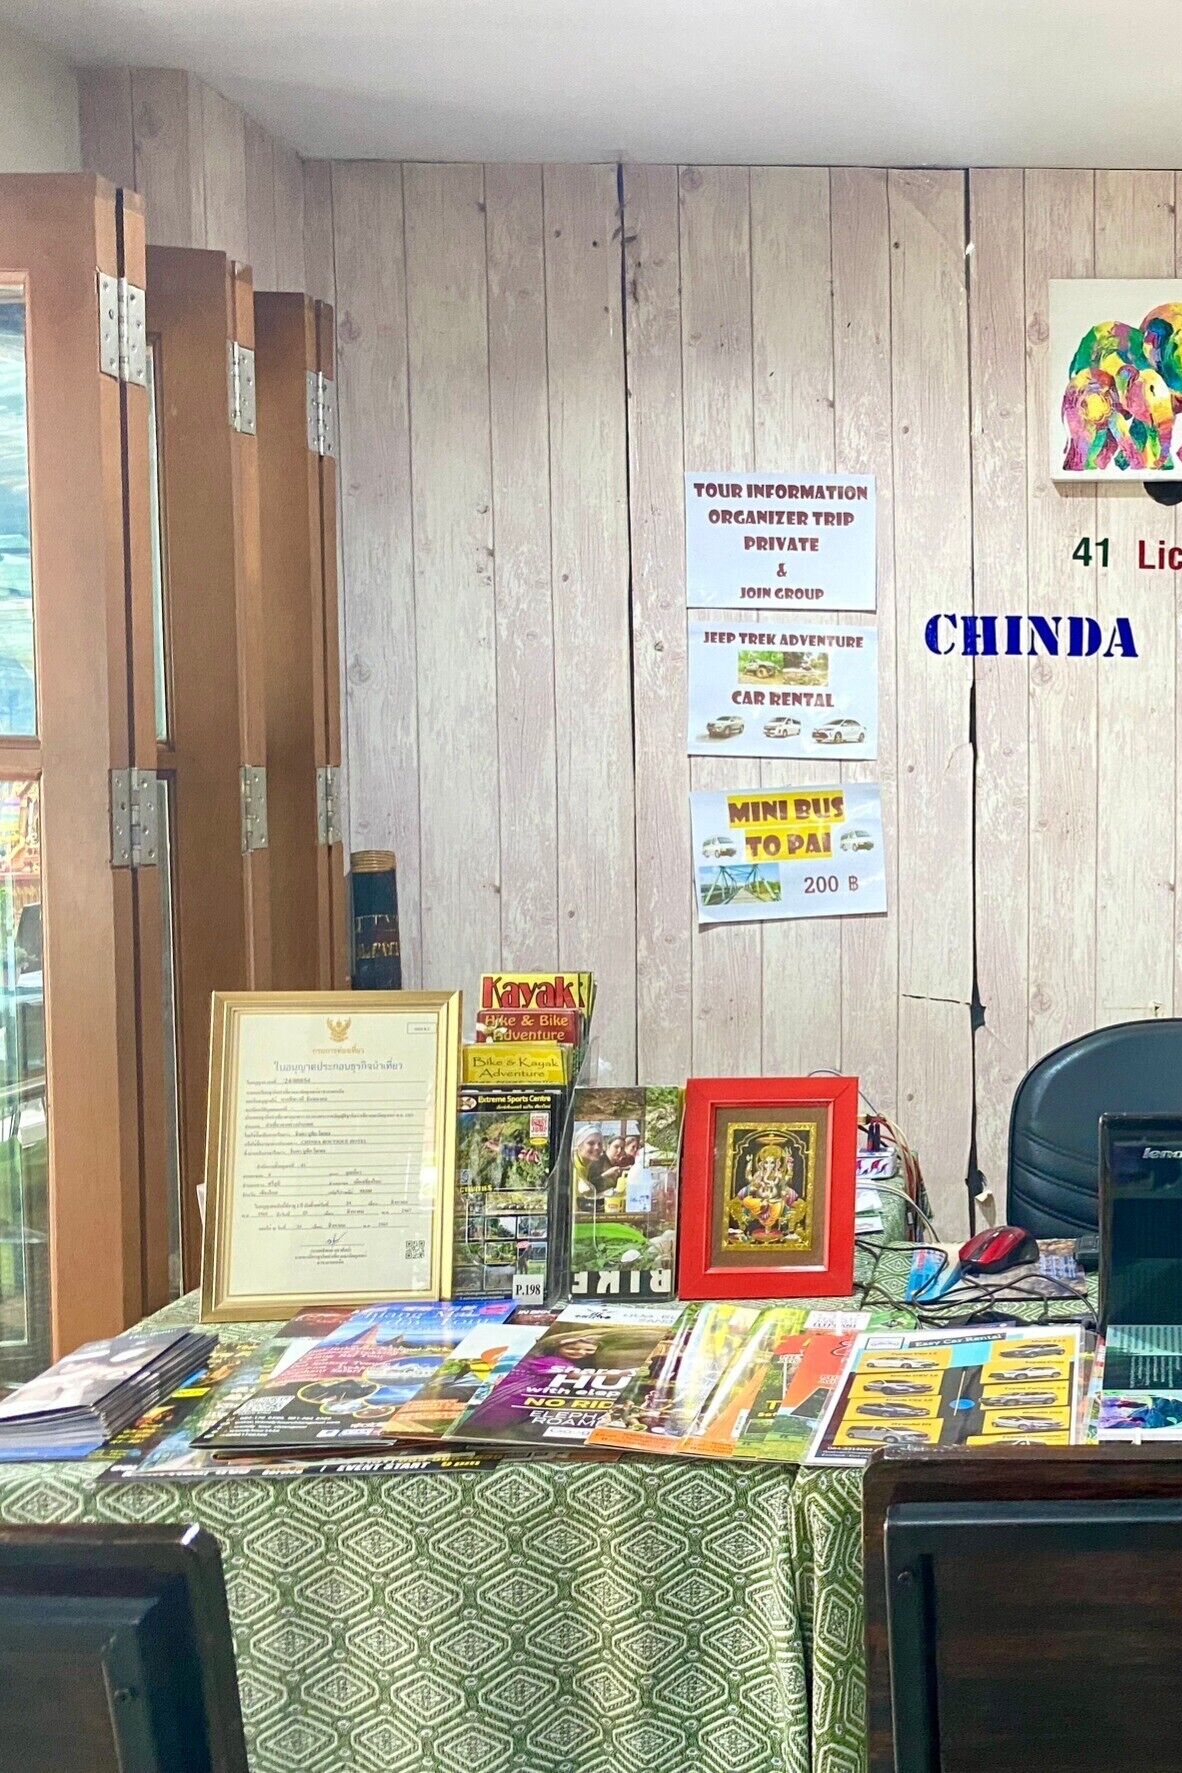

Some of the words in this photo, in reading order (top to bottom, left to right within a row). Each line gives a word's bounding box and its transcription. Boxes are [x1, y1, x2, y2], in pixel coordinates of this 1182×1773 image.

[694, 482, 742, 498] TOUR
[747, 484, 868, 500] INFORMATION
[708, 509, 808, 525] ORGANIZER
[812, 511, 854, 526] TRIP
[744, 536, 819, 551] PRIVATE
[1072, 537, 1109, 567] 41
[776, 563, 787, 577] &
[740, 587, 771, 599] JOIN
[775, 588, 824, 600] GROUP
[704, 631, 735, 644] JEEP
[739, 633, 776, 645] TREK
[780, 634, 863, 648] ADVENTURE
[924, 614, 1139, 658] CHINDA
[732, 691, 765, 705] CAR
[770, 692, 834, 707] RENTAL
[728, 800, 788, 823] MINI
[794, 797, 844, 820] BUS
[745, 834, 782, 857] TO
[788, 832, 831, 855] PAI
[804, 875, 838, 894] 200
[482, 976, 576, 1009] Kayak
[521, 1015, 534, 1026] &
[540, 1015, 568, 1026] Bike
[472, 1056, 503, 1067] Bike
[519, 1058, 558, 1069] Kayak
[479, 1068, 545, 1078] Adventure
[515, 1283, 541, 1296] P.198
[525, 1386, 571, 1395] with
[524, 1397, 566, 1407] NO
